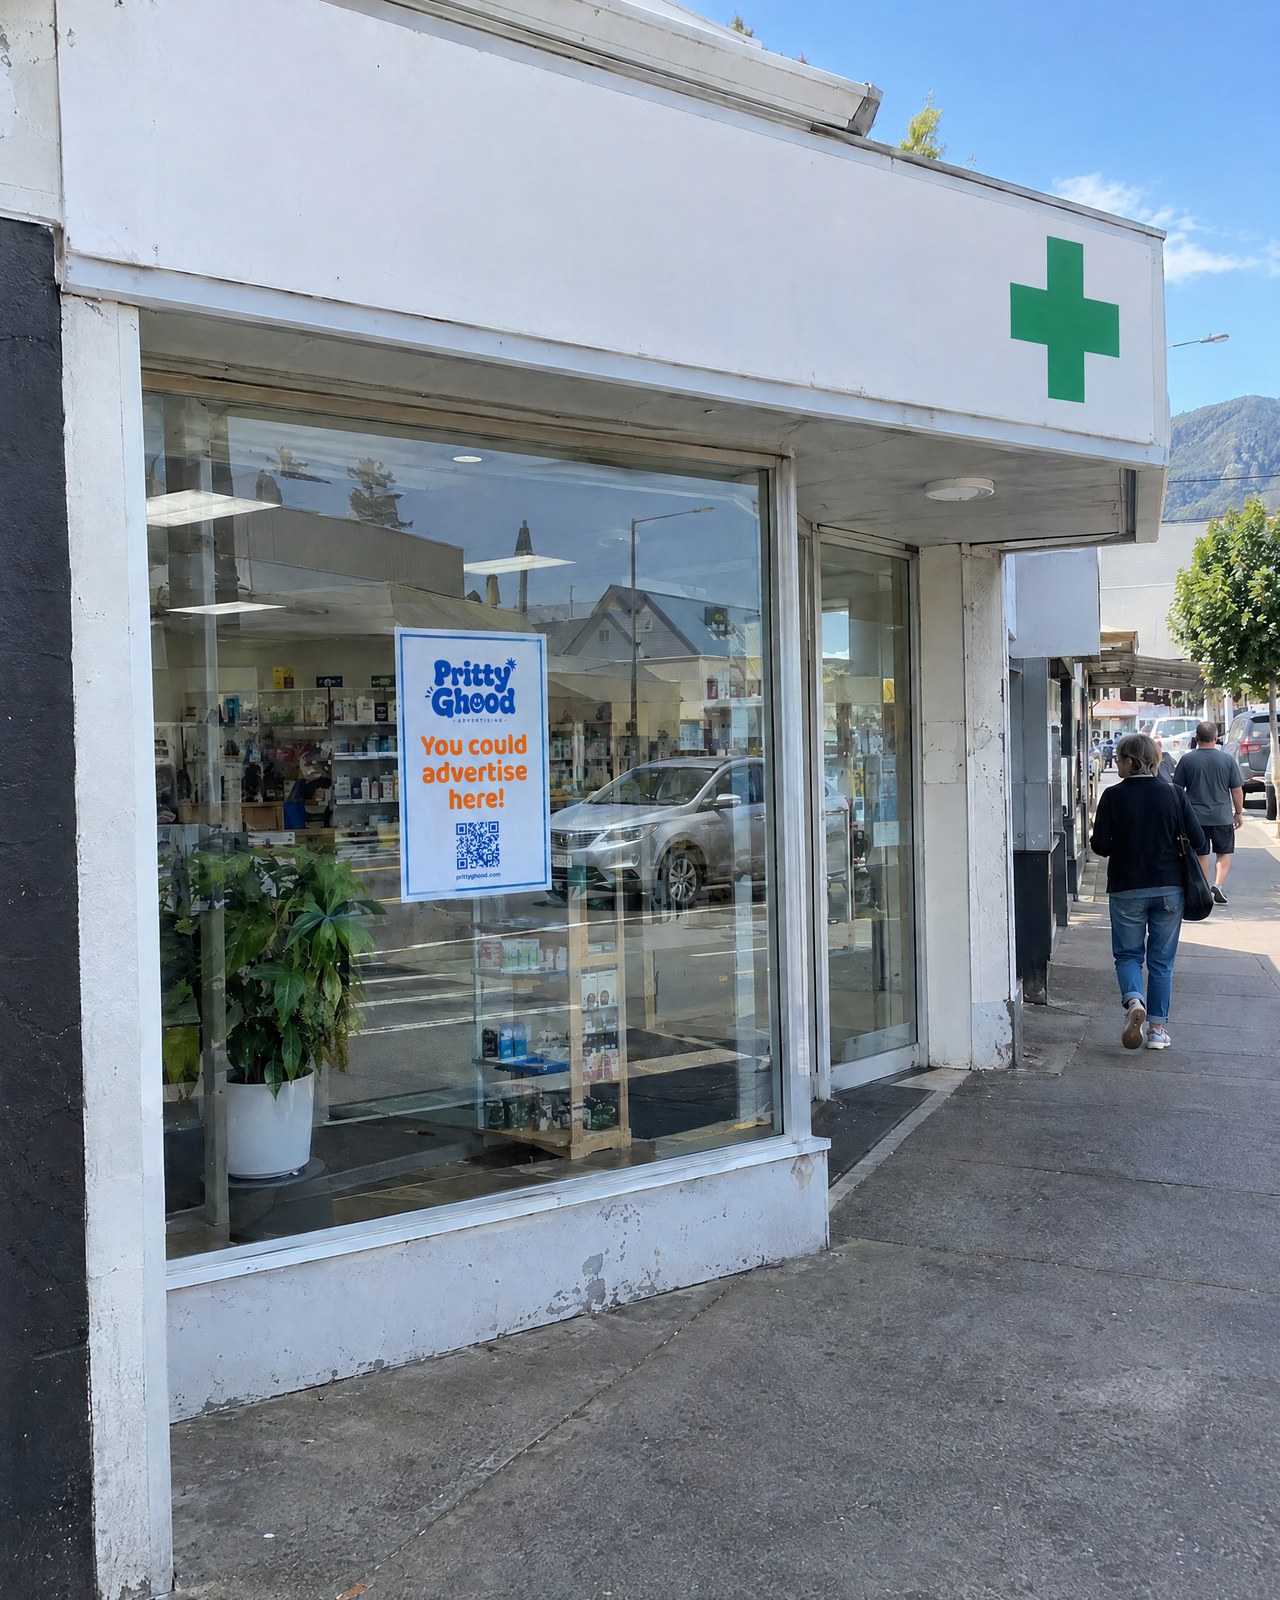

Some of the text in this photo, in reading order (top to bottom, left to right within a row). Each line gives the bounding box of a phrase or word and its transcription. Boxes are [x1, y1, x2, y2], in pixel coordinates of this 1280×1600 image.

[434, 659, 513, 693] Pritty
[431, 687, 517, 719] Ghood
[420, 733, 528, 757] You could
[422, 759, 528, 785] advertise
[448, 787, 505, 811] here!
[456, 872, 502, 881] prittyghood.com
